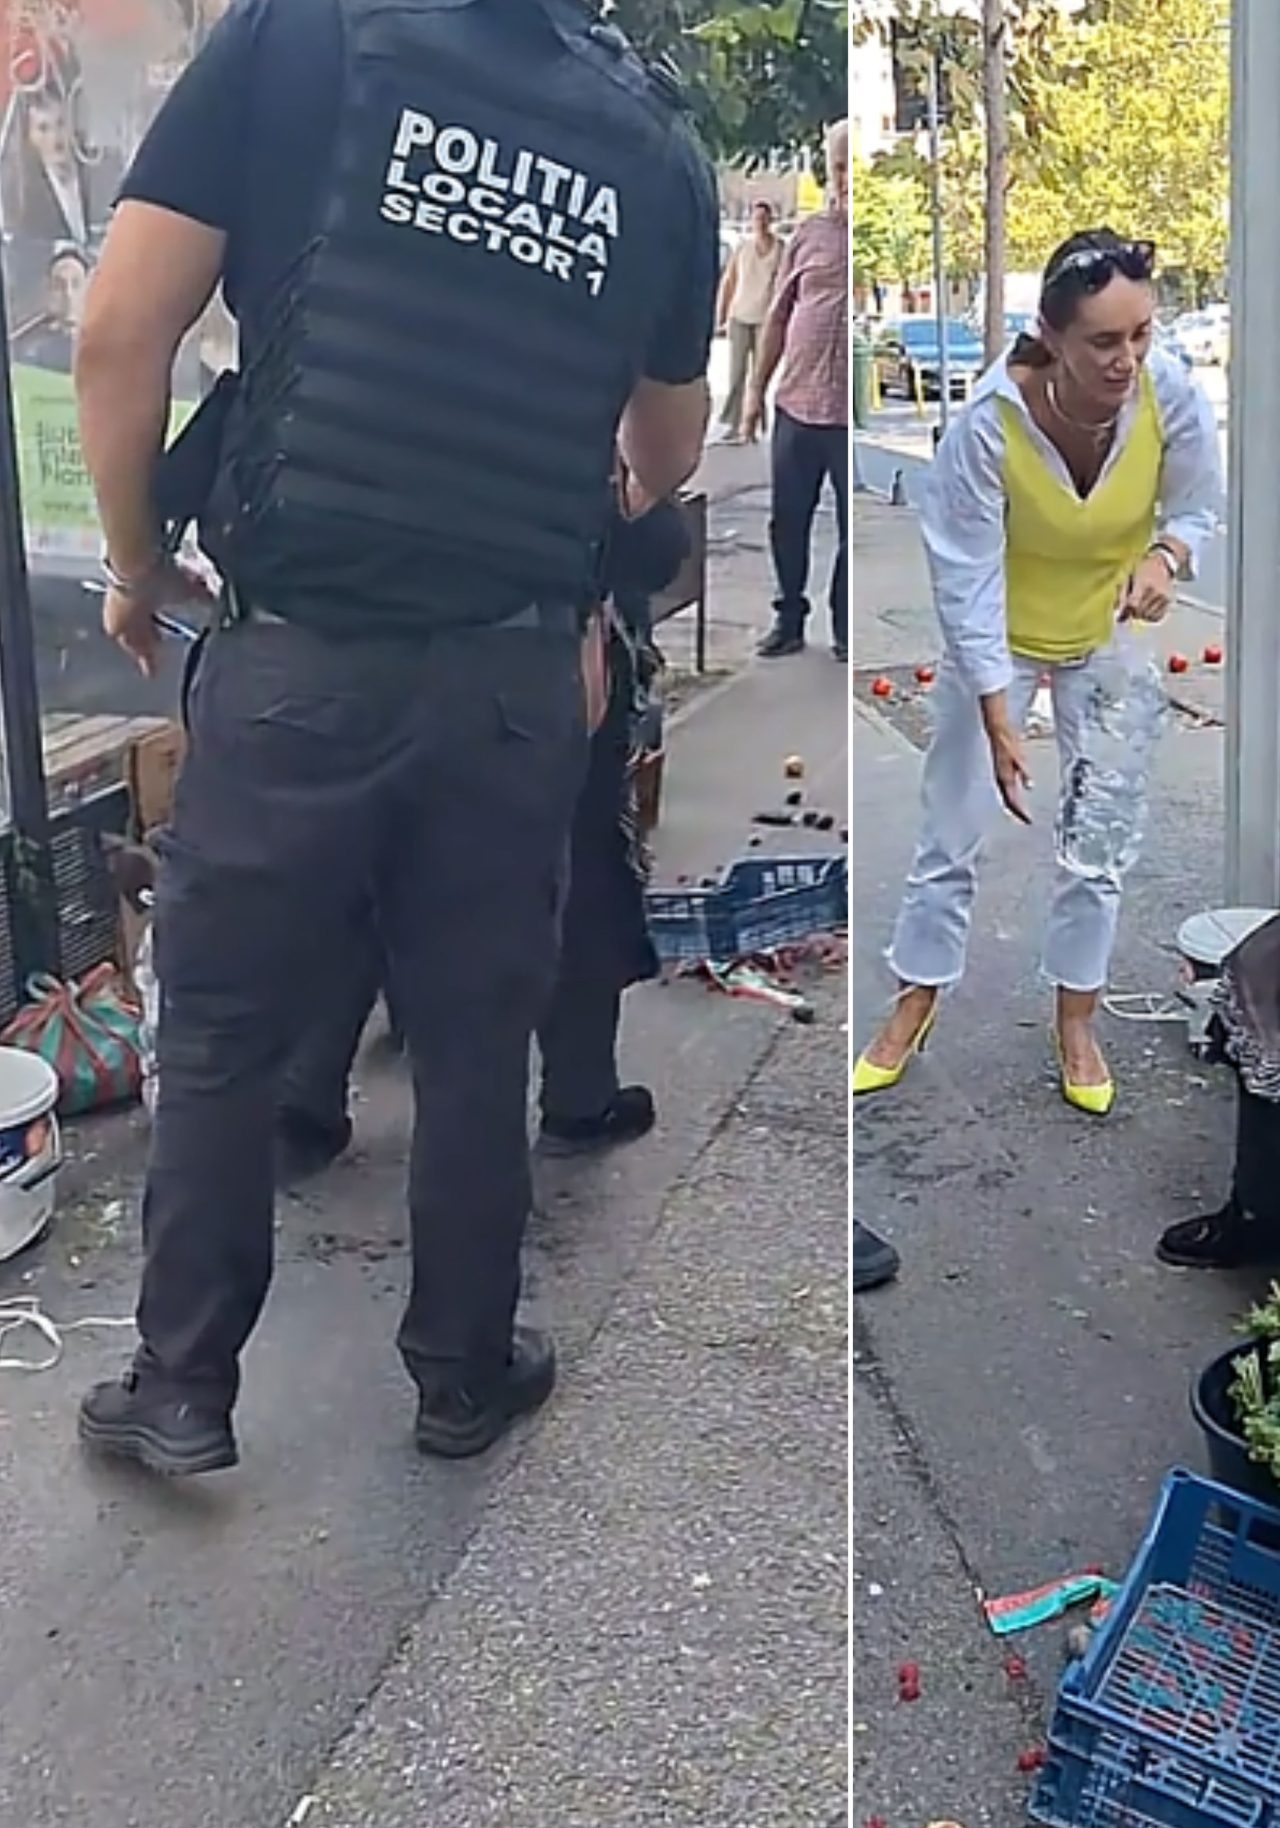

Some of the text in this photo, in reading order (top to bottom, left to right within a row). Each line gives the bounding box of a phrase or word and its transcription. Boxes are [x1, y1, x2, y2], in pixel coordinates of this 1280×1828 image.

[386, 158, 608, 267] LOCALA
[393, 108, 618, 238] POLITIA
[380, 193, 605, 297] SECTOR 1
